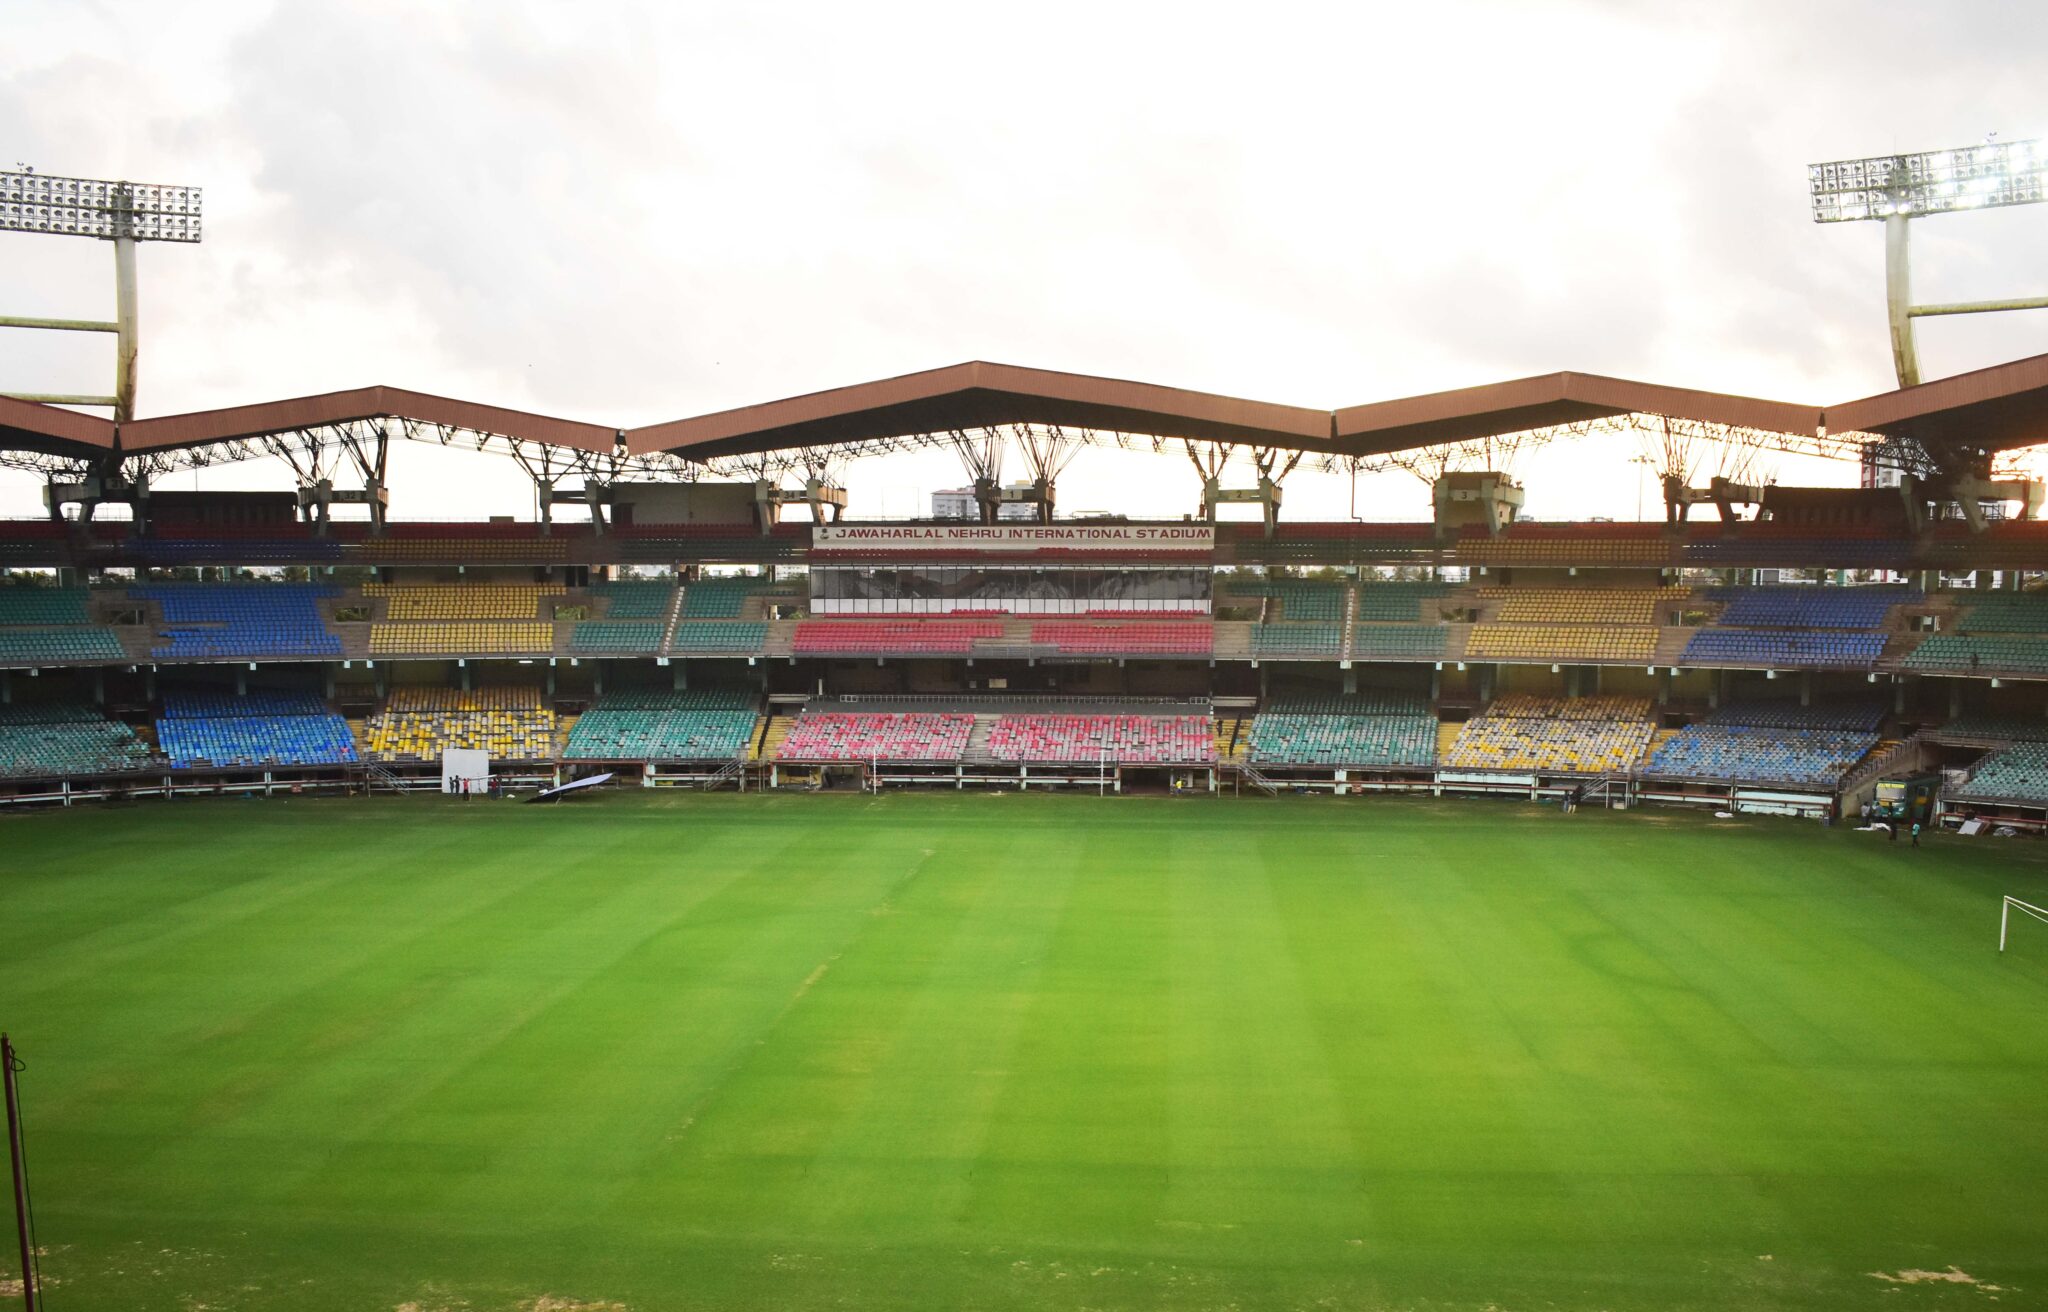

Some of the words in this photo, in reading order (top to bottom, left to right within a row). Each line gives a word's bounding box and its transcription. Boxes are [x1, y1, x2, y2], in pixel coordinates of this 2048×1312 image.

[784, 491, 795, 499] 34
[1461, 491, 1467, 499] 3
[835, 528, 944, 539] JAWAHARLAL
[948, 528, 1002, 539] NEHRU
[1008, 529, 1132, 539] INTERNATIONAL
[1135, 529, 1211, 539] STADIUM
